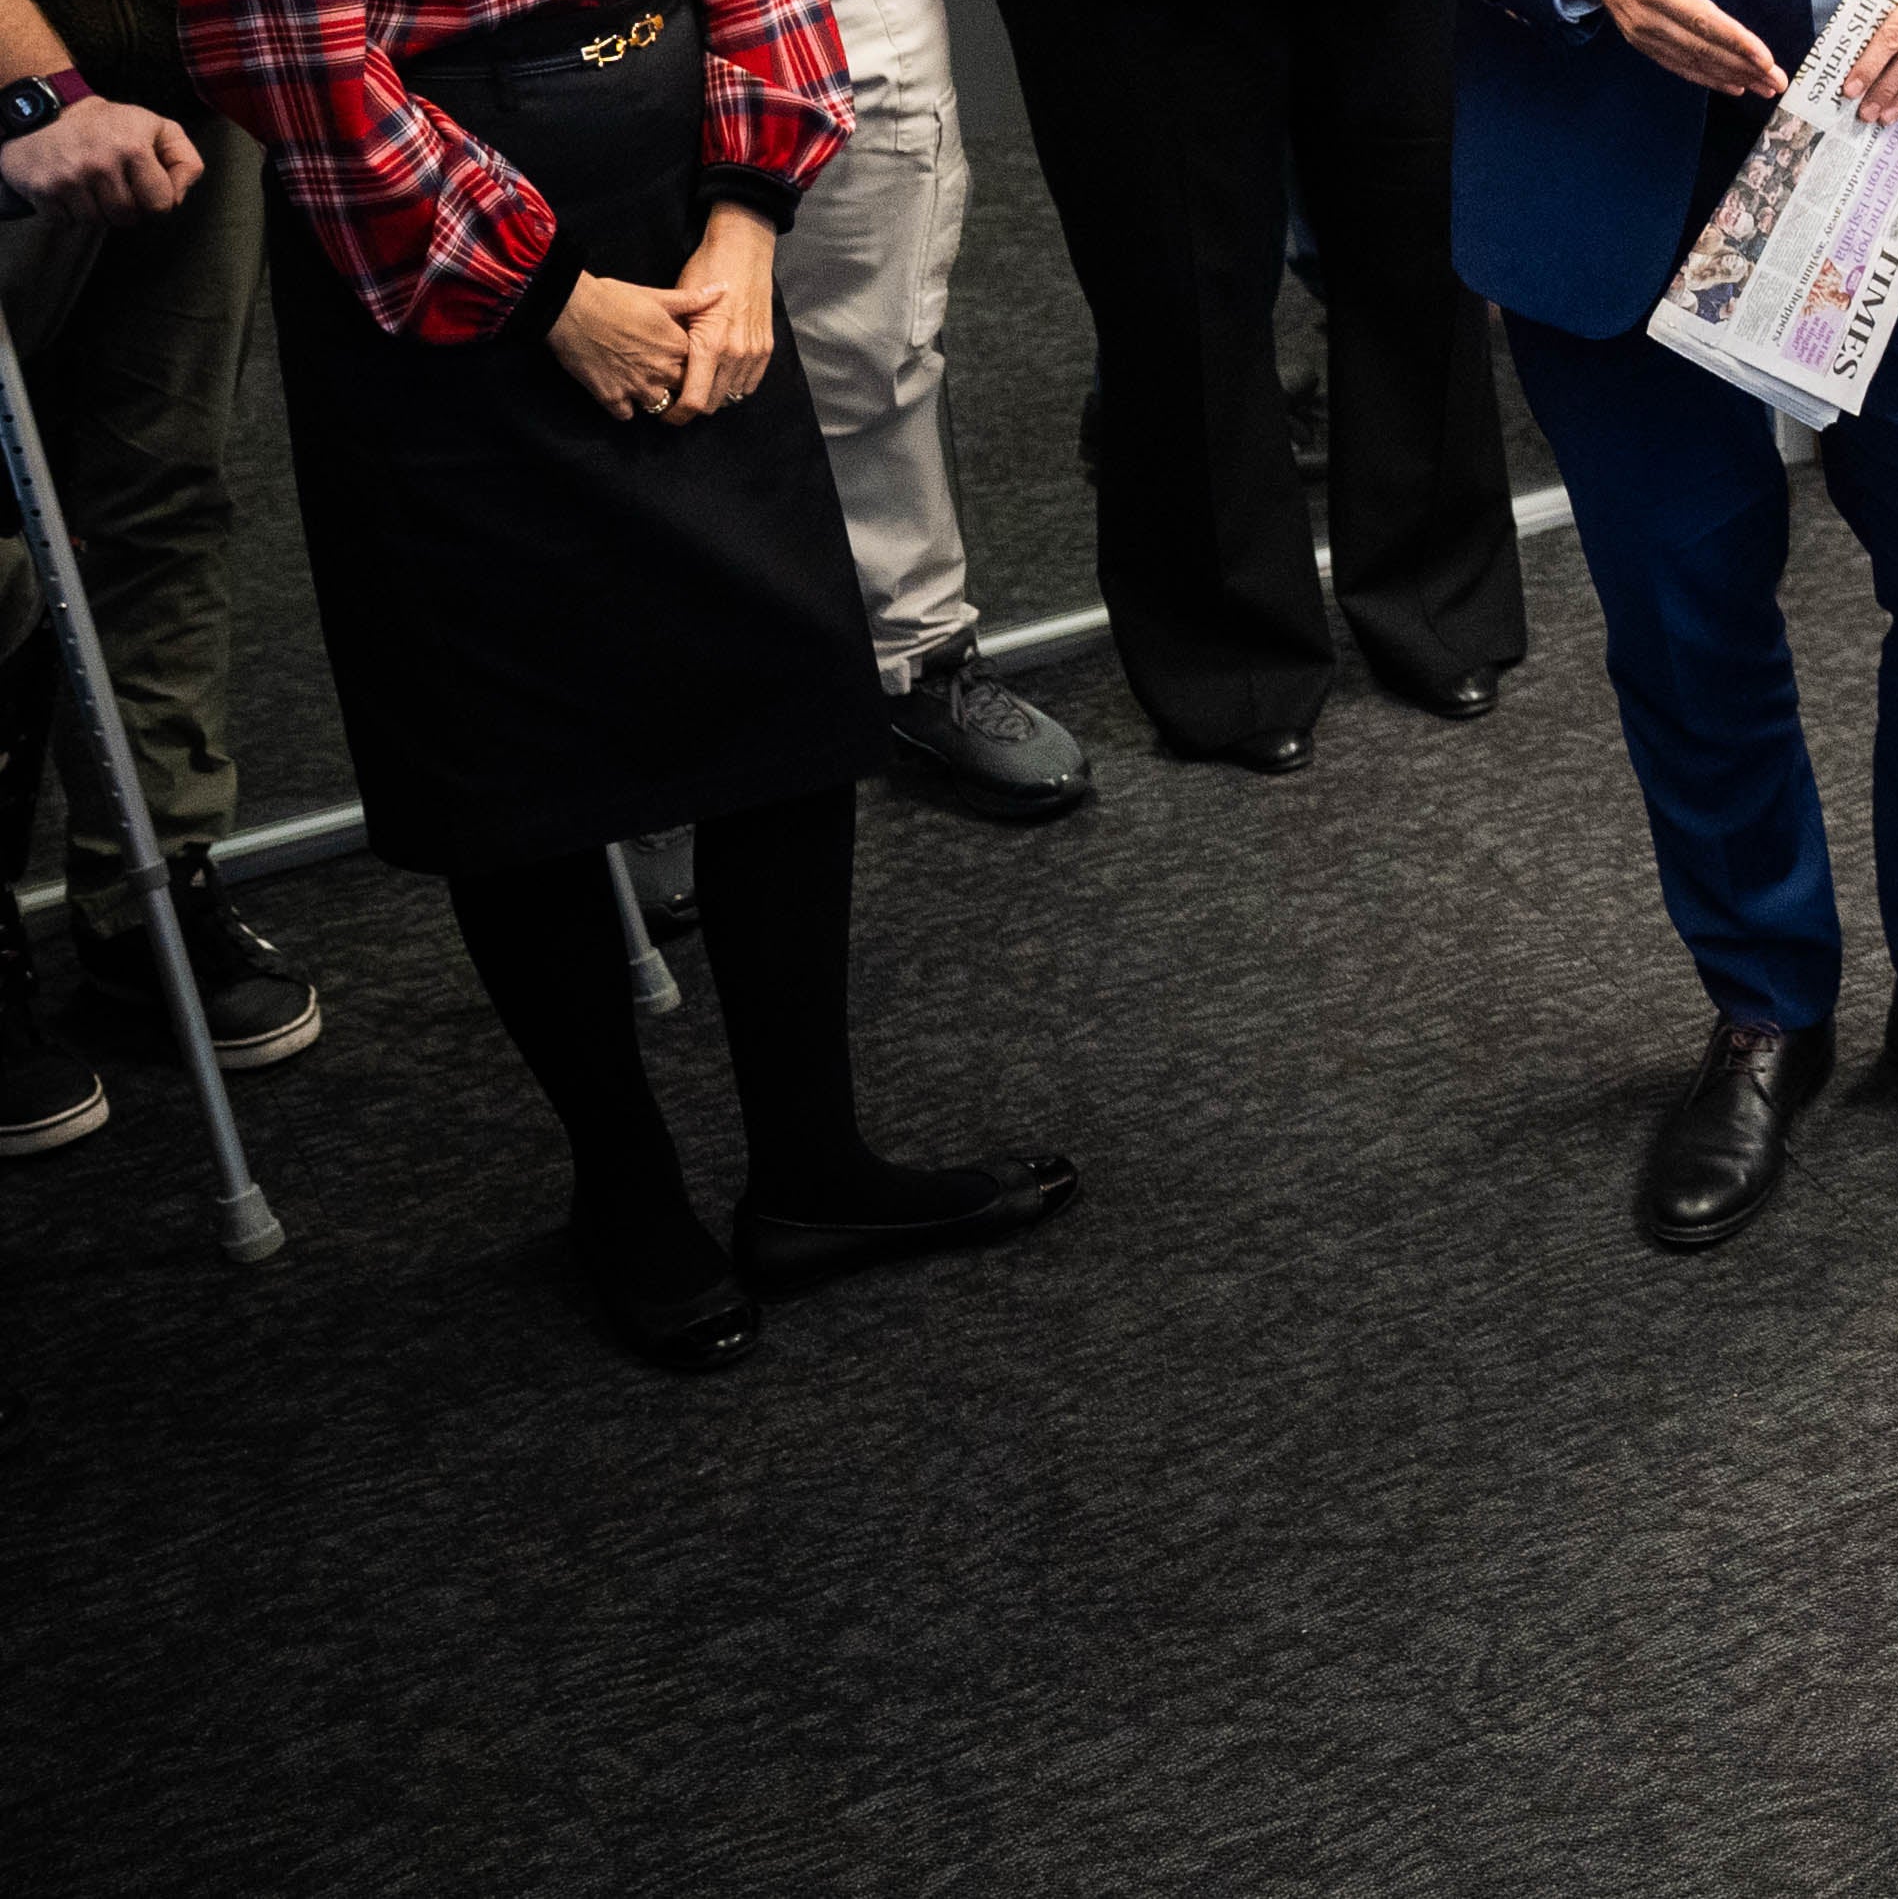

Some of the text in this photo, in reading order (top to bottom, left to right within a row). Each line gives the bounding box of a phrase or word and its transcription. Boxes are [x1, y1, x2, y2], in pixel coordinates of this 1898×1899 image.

[1805, 34, 1851, 104] strikes
[1852, 159, 1866, 174] to
[1862, 157, 1890, 200] from
[1837, 173, 1861, 208] drive
[1822, 205, 1844, 237] away
[1864, 195, 1890, 229] The
[1849, 230, 1874, 264] pop
